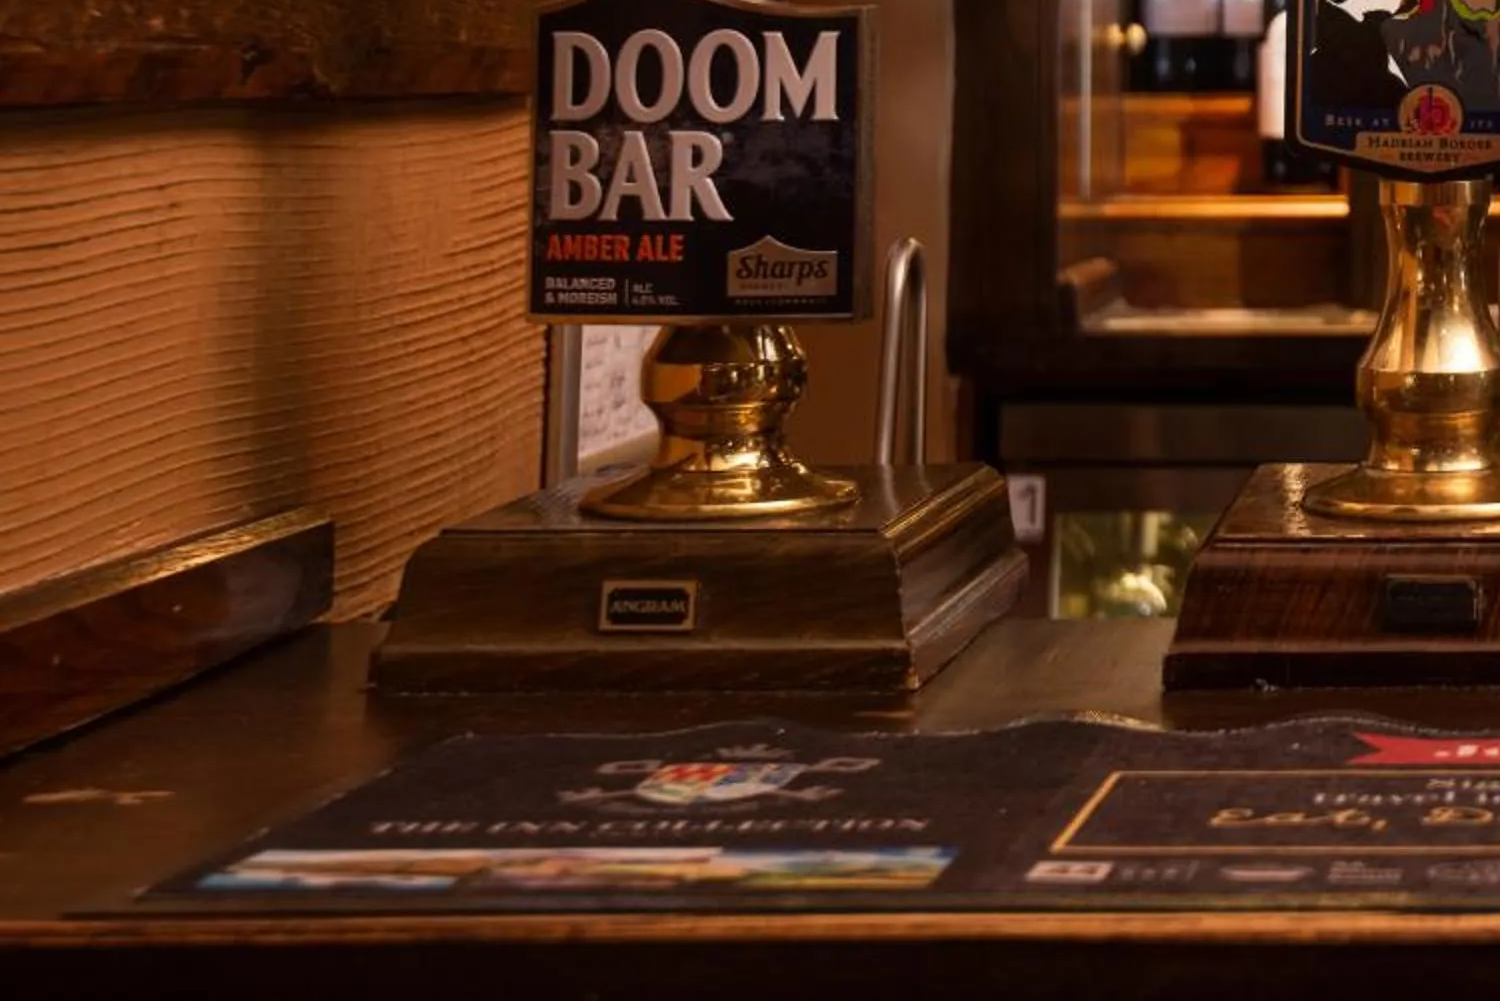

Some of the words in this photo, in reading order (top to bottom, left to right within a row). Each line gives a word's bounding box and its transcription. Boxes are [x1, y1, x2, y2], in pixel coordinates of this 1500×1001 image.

[550, 27, 841, 123] DOOM
[548, 130, 735, 222] BAR
[546, 233, 630, 262] AMBER
[635, 233, 685, 262] ALE
[544, 276, 616, 290] BALANCED
[1207, 807, 1390, 831] Eat,
